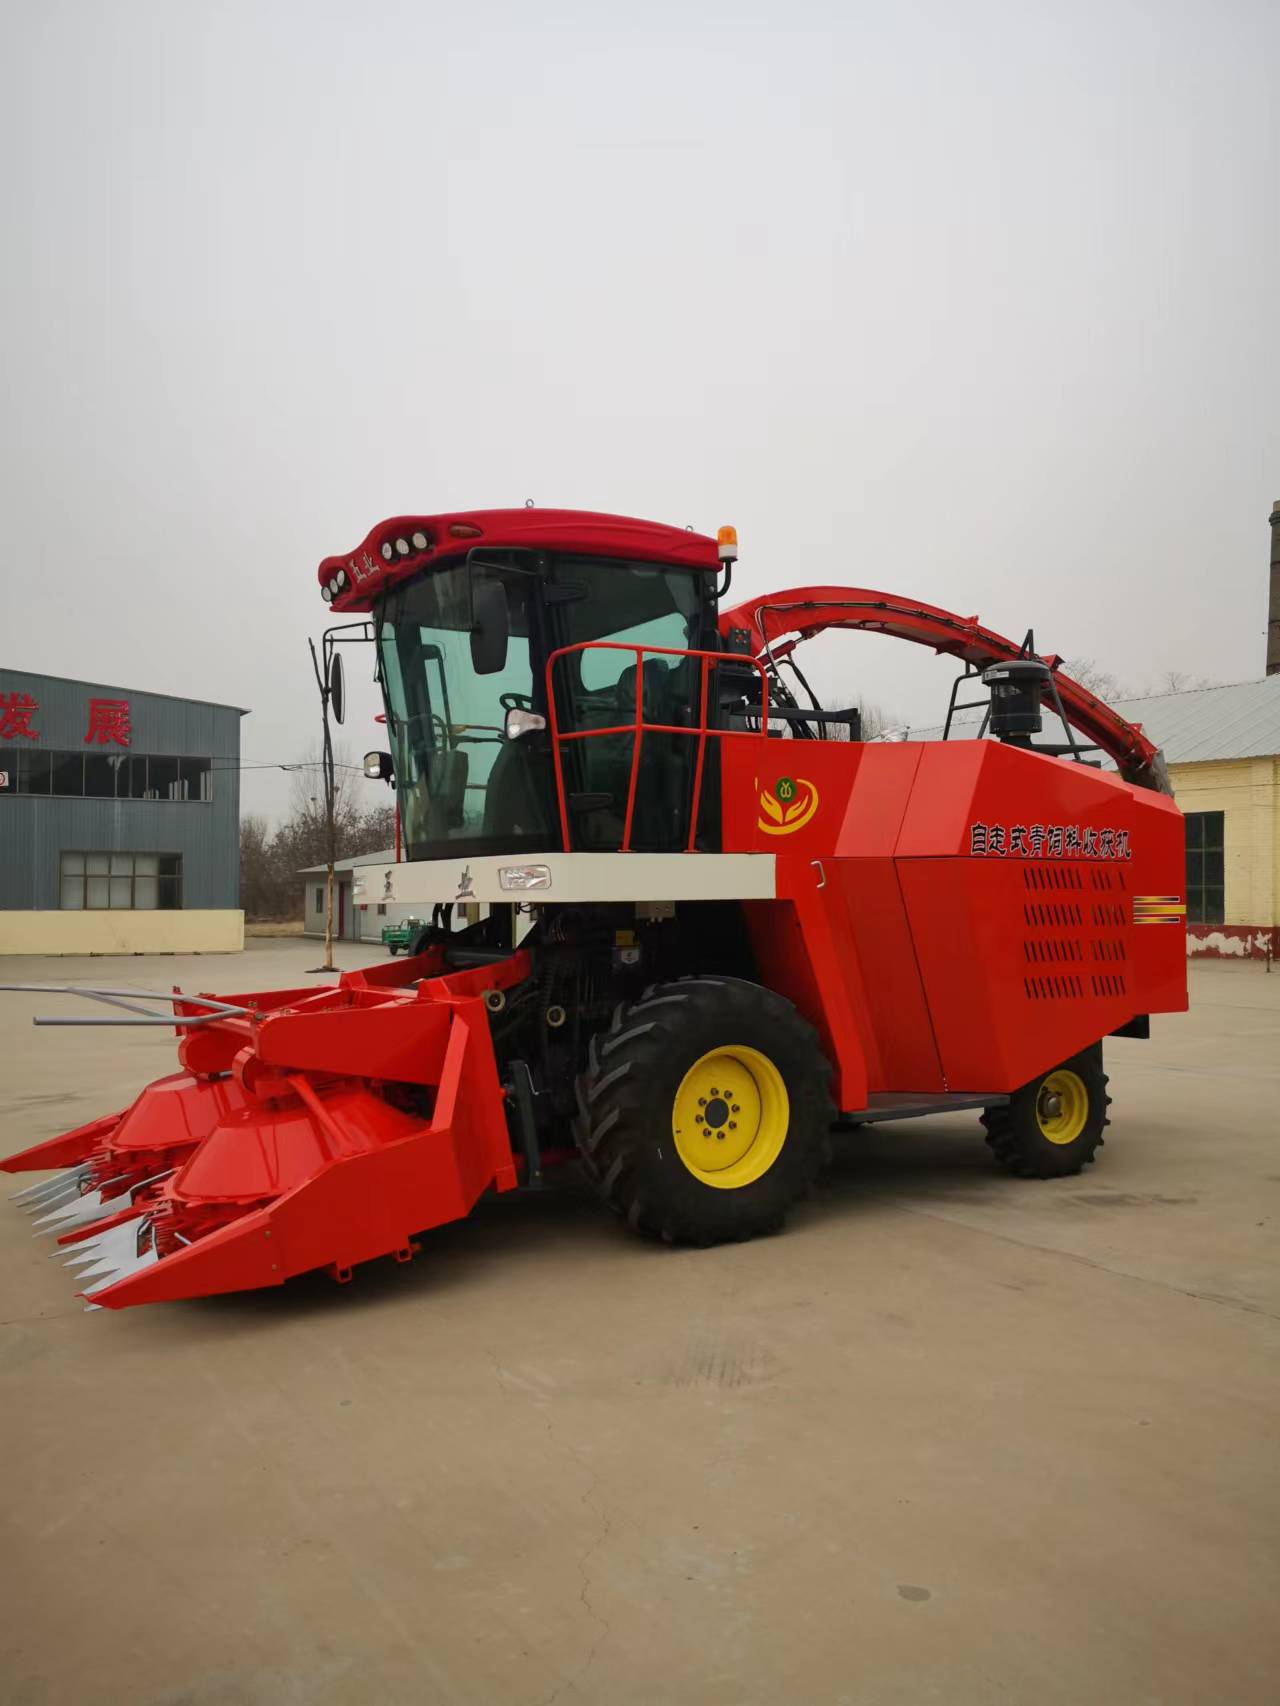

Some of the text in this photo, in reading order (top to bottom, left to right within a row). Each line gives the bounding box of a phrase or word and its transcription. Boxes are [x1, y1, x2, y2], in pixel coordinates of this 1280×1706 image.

[0, 690, 131, 748] 发展
[971, 821, 1132, 860] 自走式青饲料收获机
